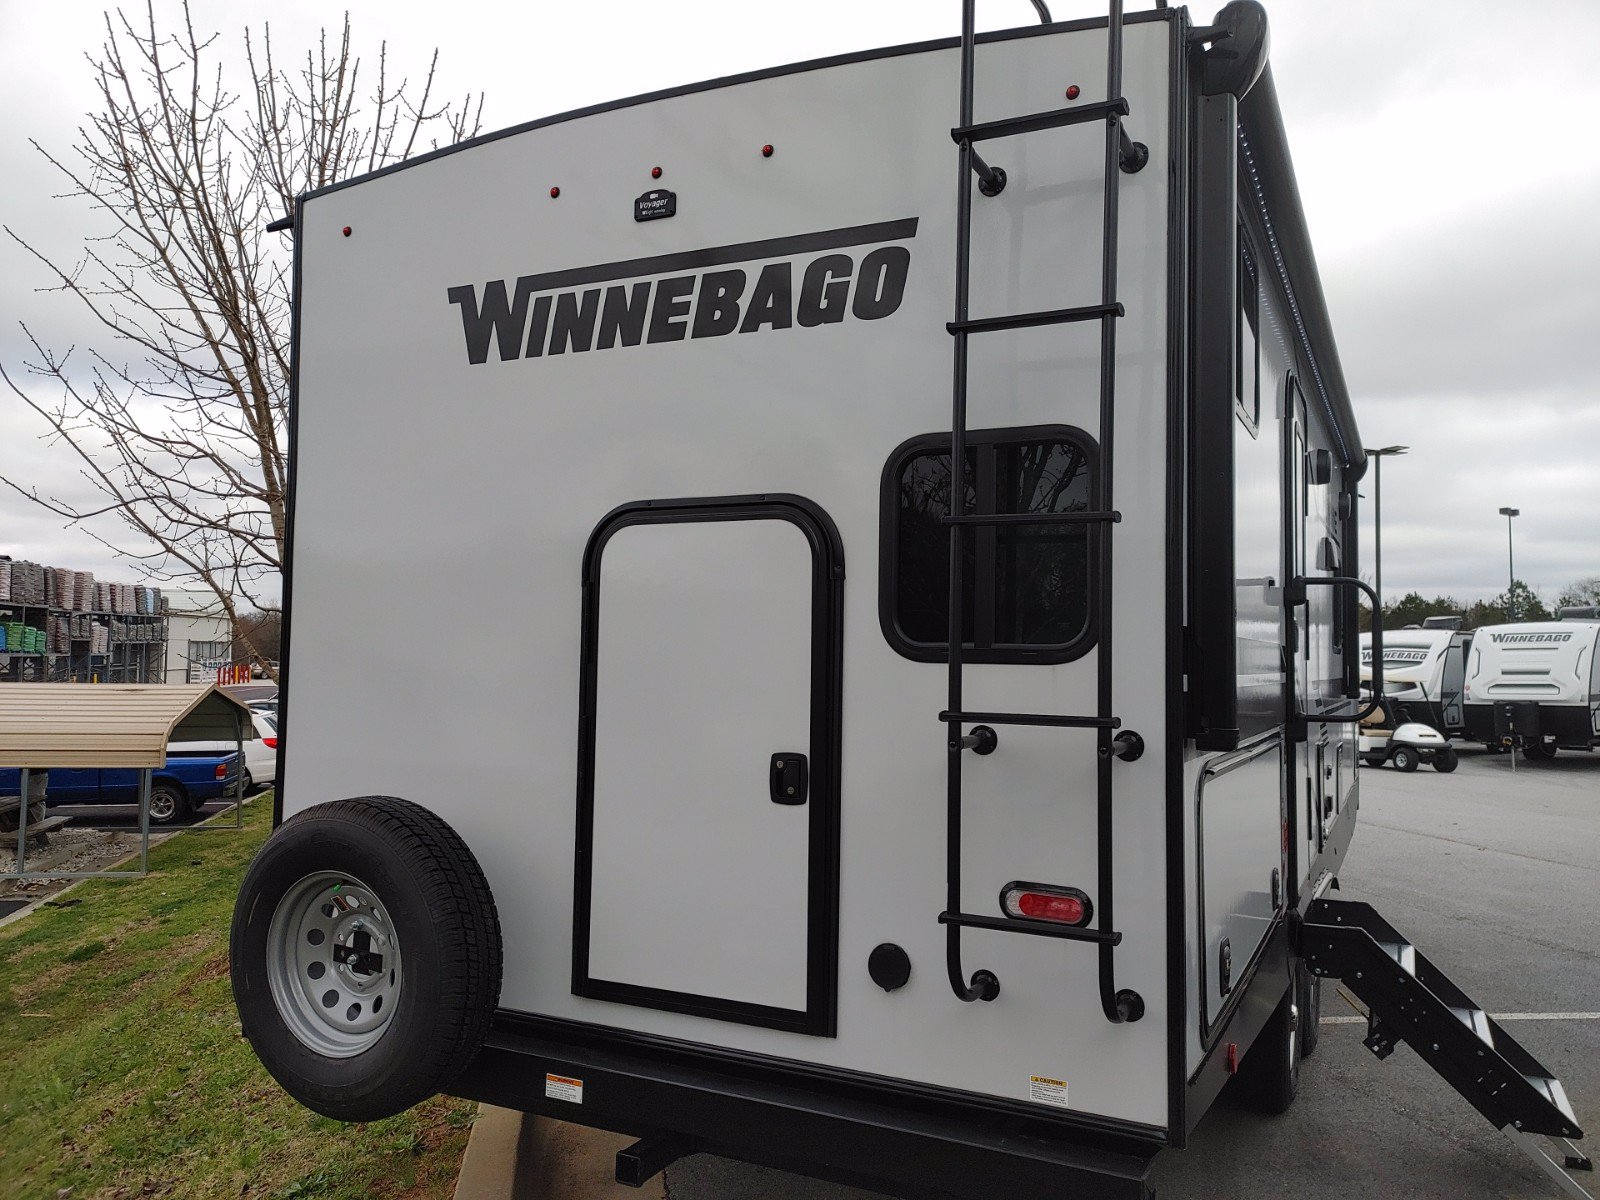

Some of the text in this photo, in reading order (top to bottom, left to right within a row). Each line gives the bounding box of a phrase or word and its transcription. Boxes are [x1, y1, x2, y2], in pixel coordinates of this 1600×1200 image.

[640, 199, 668, 209] Voyager
[447, 217, 919, 365] WINNEBAGO
[1490, 632, 1573, 643] WINNEBAGO
[1361, 650, 1429, 660] WNEBAGO
[1039, 1077, 1063, 1086] CAUTION
